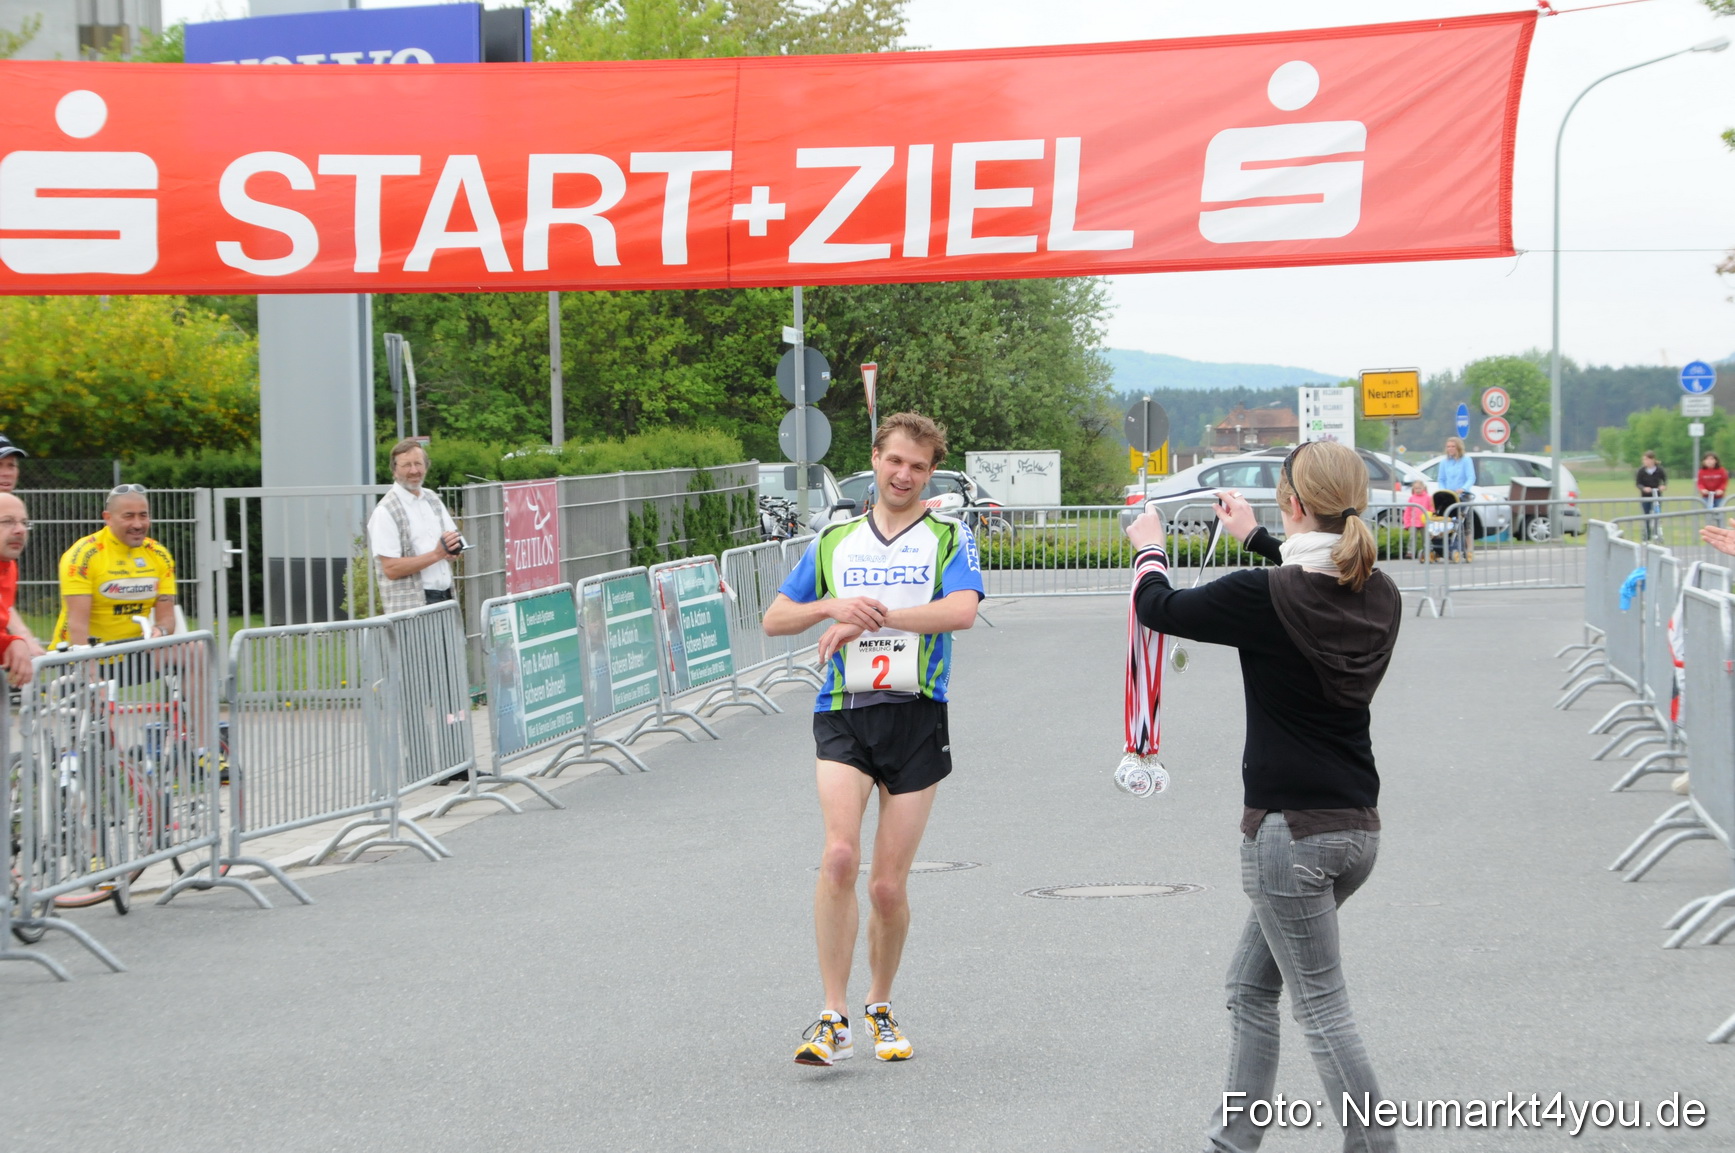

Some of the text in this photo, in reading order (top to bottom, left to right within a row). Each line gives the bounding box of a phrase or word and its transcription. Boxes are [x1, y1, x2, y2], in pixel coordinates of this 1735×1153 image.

[1368, 388, 1414, 399] Neumarkt
[1489, 395, 1504, 408] 60
[514, 534, 554, 570] ZEITLOS
[848, 554, 887, 563] TEAM
[844, 566, 930, 587] BOCK
[101, 583, 153, 594] Mercatone
[859, 640, 891, 648] MEYER
[522, 655, 532, 676] Fun
[538, 650, 554, 672] Action
[872, 655, 892, 690] 2
